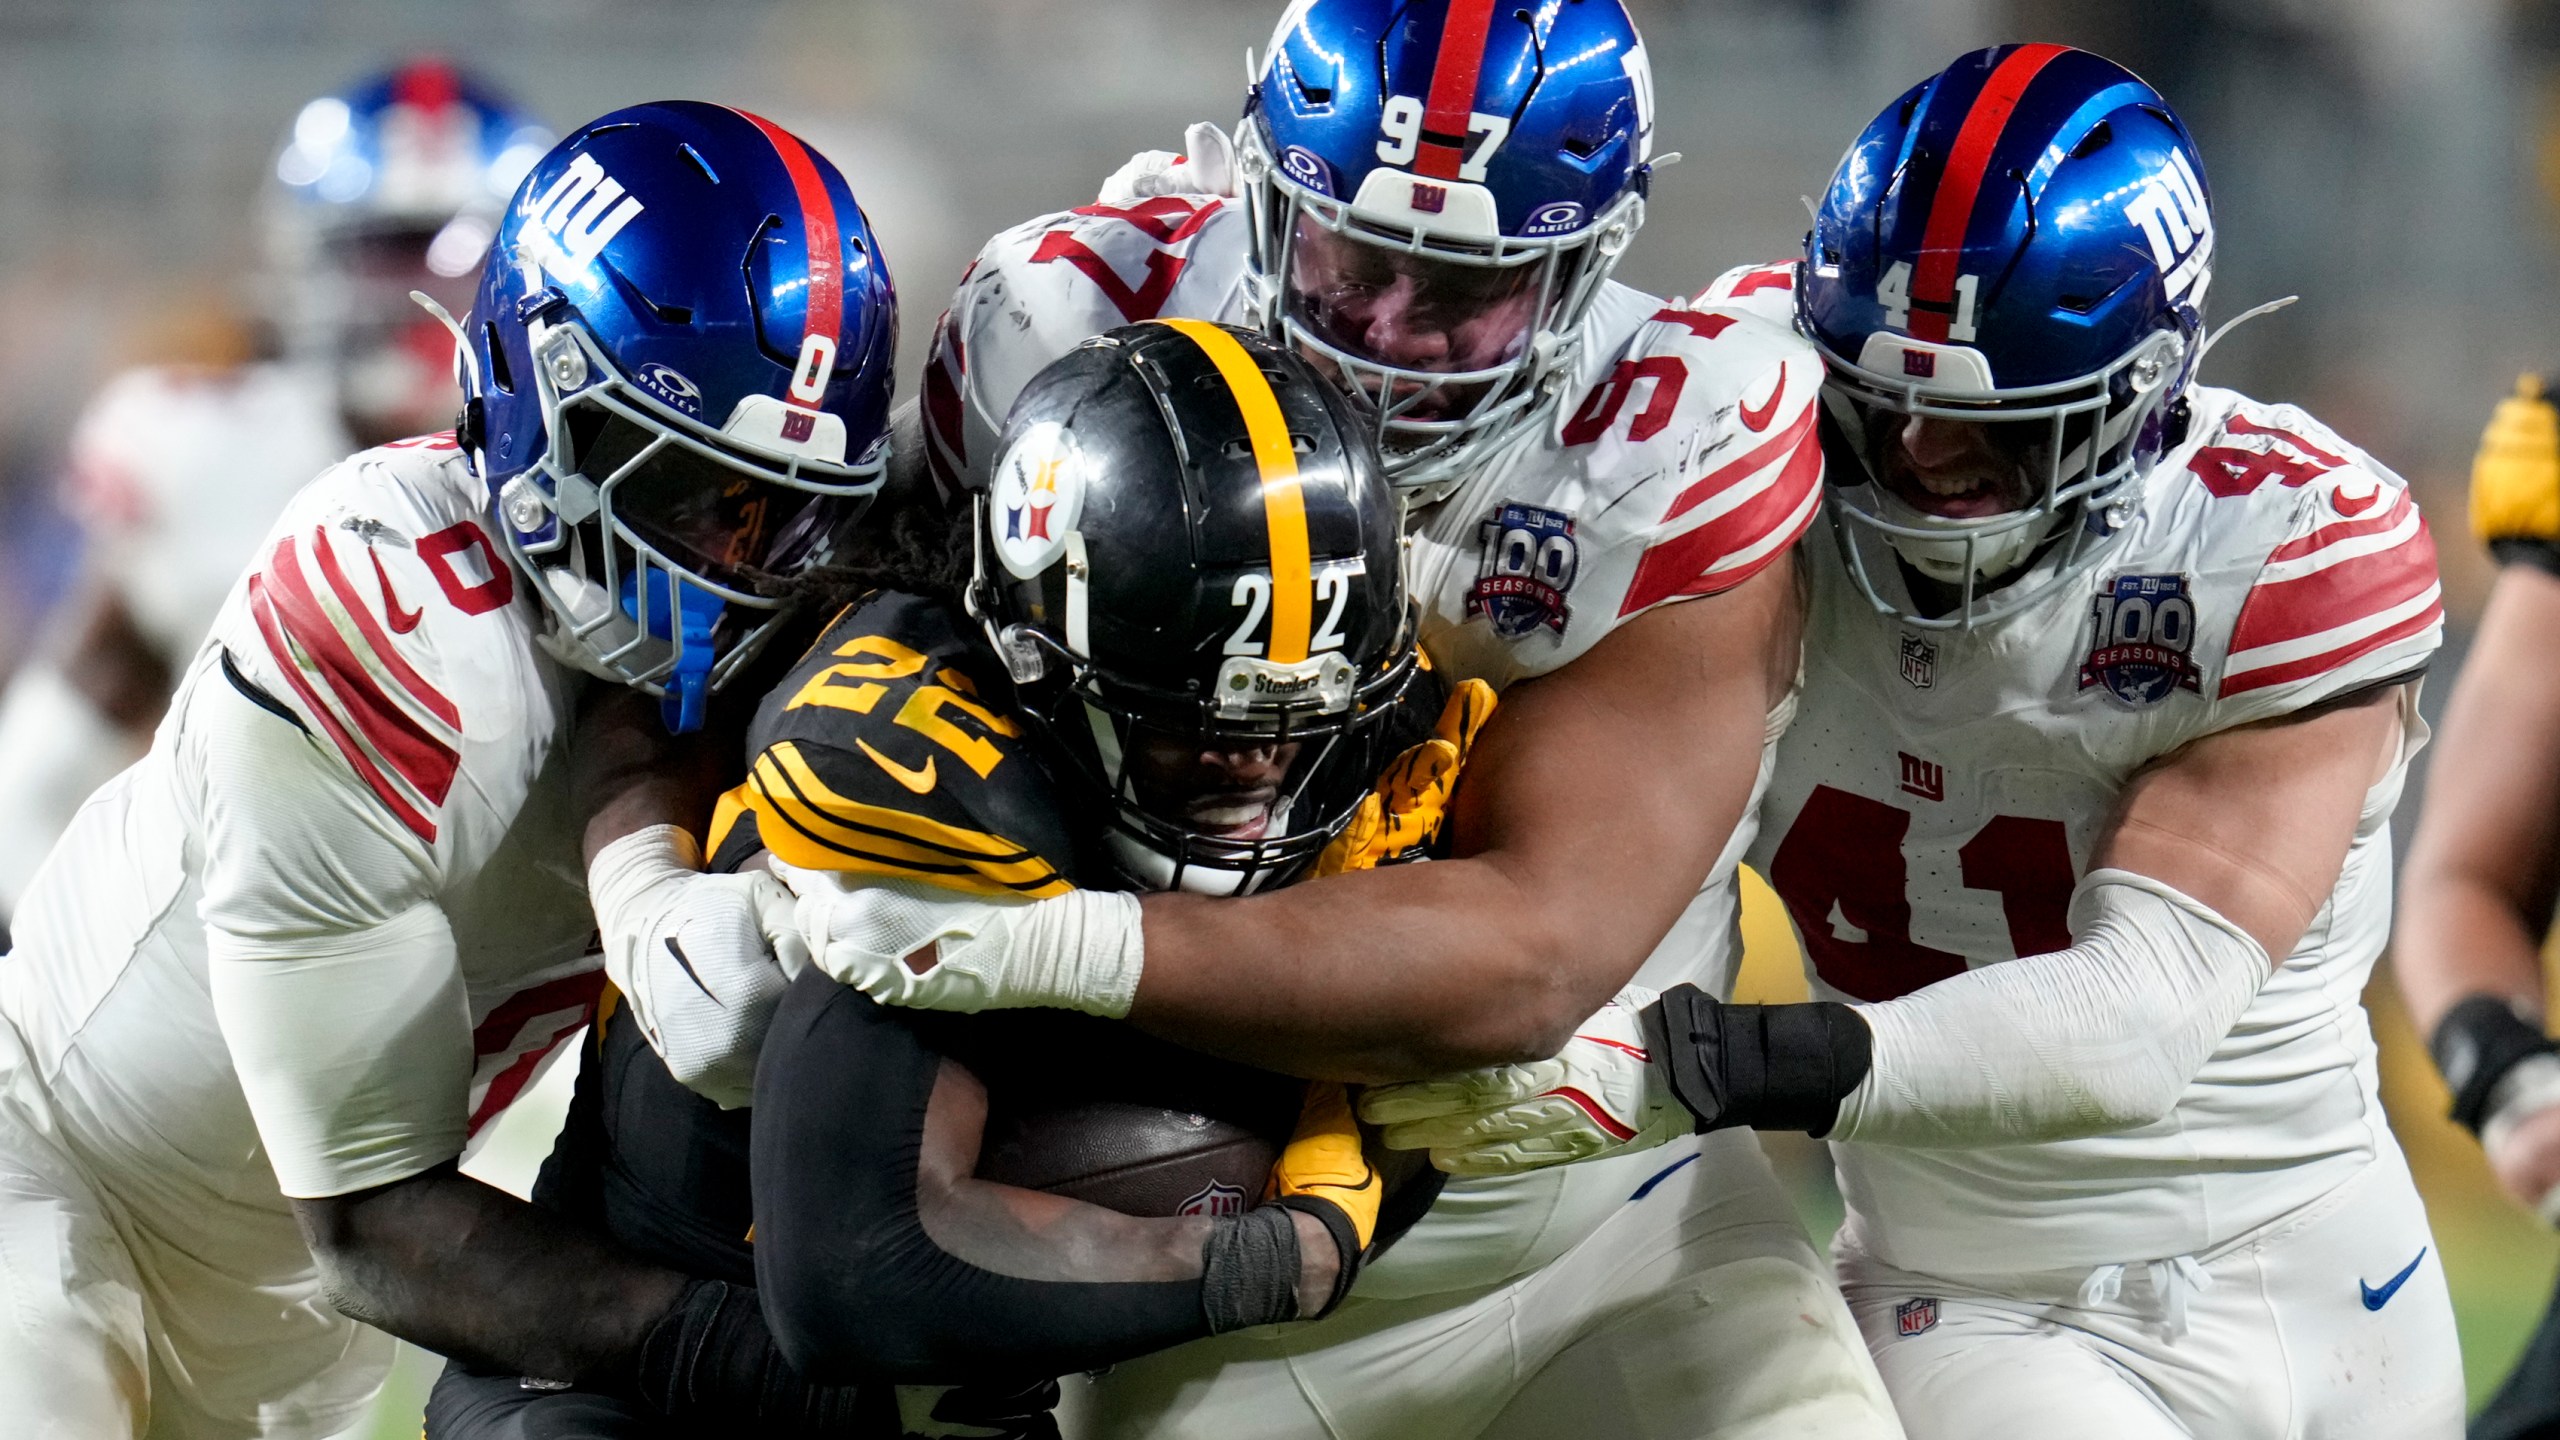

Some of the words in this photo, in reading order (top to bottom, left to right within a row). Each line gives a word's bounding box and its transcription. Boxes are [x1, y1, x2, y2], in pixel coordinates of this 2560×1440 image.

[1376, 94, 1511, 183] 97
[1282, 160, 1325, 191] OAKLEY
[1527, 220, 1582, 234] OAKLEY
[1876, 259, 1980, 343] 41
[637, 372, 698, 415] OAKLEY
[790, 333, 836, 404] 0
[2186, 413, 2350, 499] 41
[415, 519, 514, 617] 0
[1480, 525, 1576, 591] 100
[1222, 566, 1350, 656] 22
[1481, 579, 1556, 606] SEASONS
[2096, 596, 2192, 653] 100
[1254, 672, 1321, 695] Steelers
[1904, 657, 1929, 684] NFL
[2097, 648, 2180, 668] SEASONS
[784, 635, 1024, 780] 22
[1770, 783, 2077, 1004] 41
[1900, 1307, 1934, 1332] NFL
